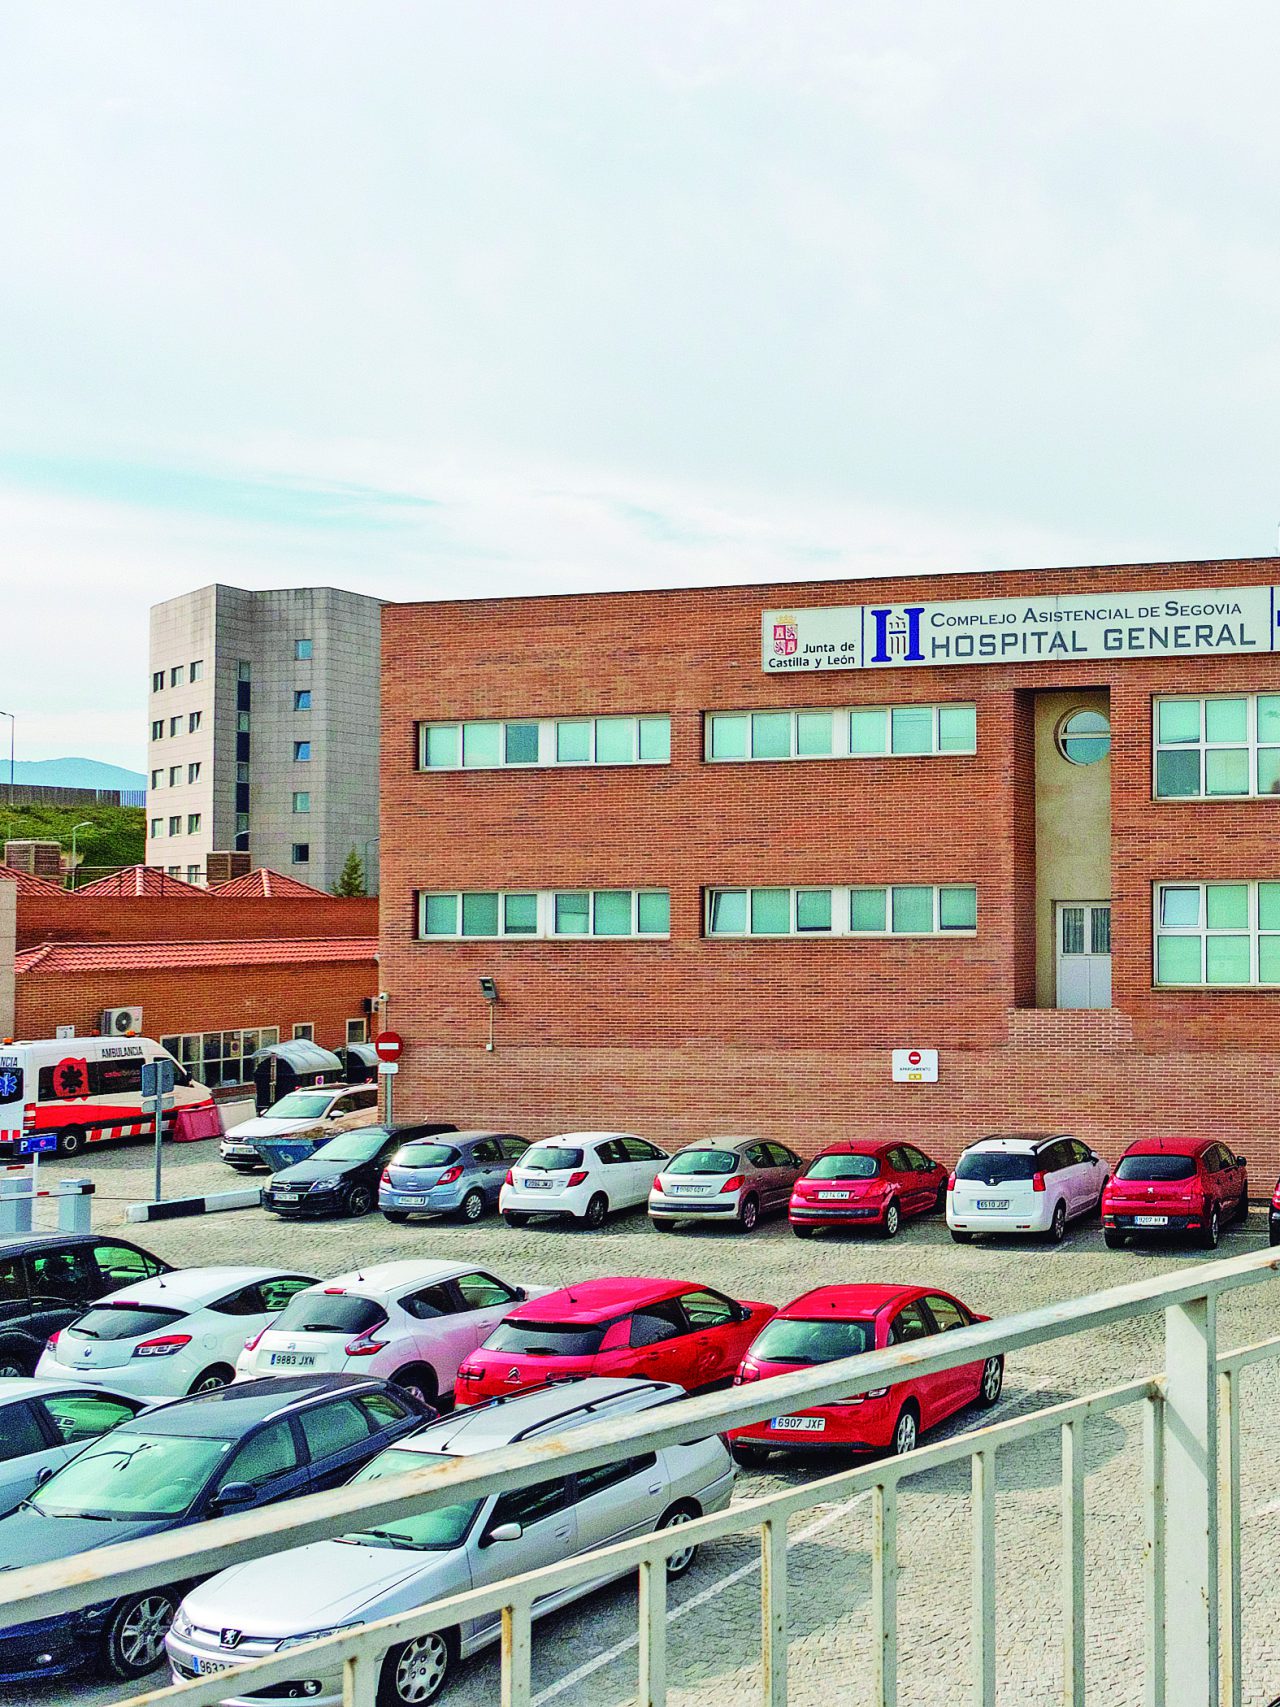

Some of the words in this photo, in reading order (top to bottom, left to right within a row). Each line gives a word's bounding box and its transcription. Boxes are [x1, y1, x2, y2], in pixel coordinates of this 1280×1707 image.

[931, 630, 1088, 658] HOSPITAL
[1103, 623, 1256, 650] GENERAL
[803, 643, 835, 653] Junta
[840, 642, 855, 651] de
[768, 656, 809, 668] Castilla
[814, 658, 822, 668] y
[827, 655, 855, 665] León
[101, 1046, 143, 1058] AMBULANCIA
[20, 1141, 29, 1151] P
[276, 1355, 297, 1365] 9883
[298, 1356, 315, 1365] JXN
[778, 1418, 803, 1428] 6907
[805, 1419, 824, 1429] JXF
